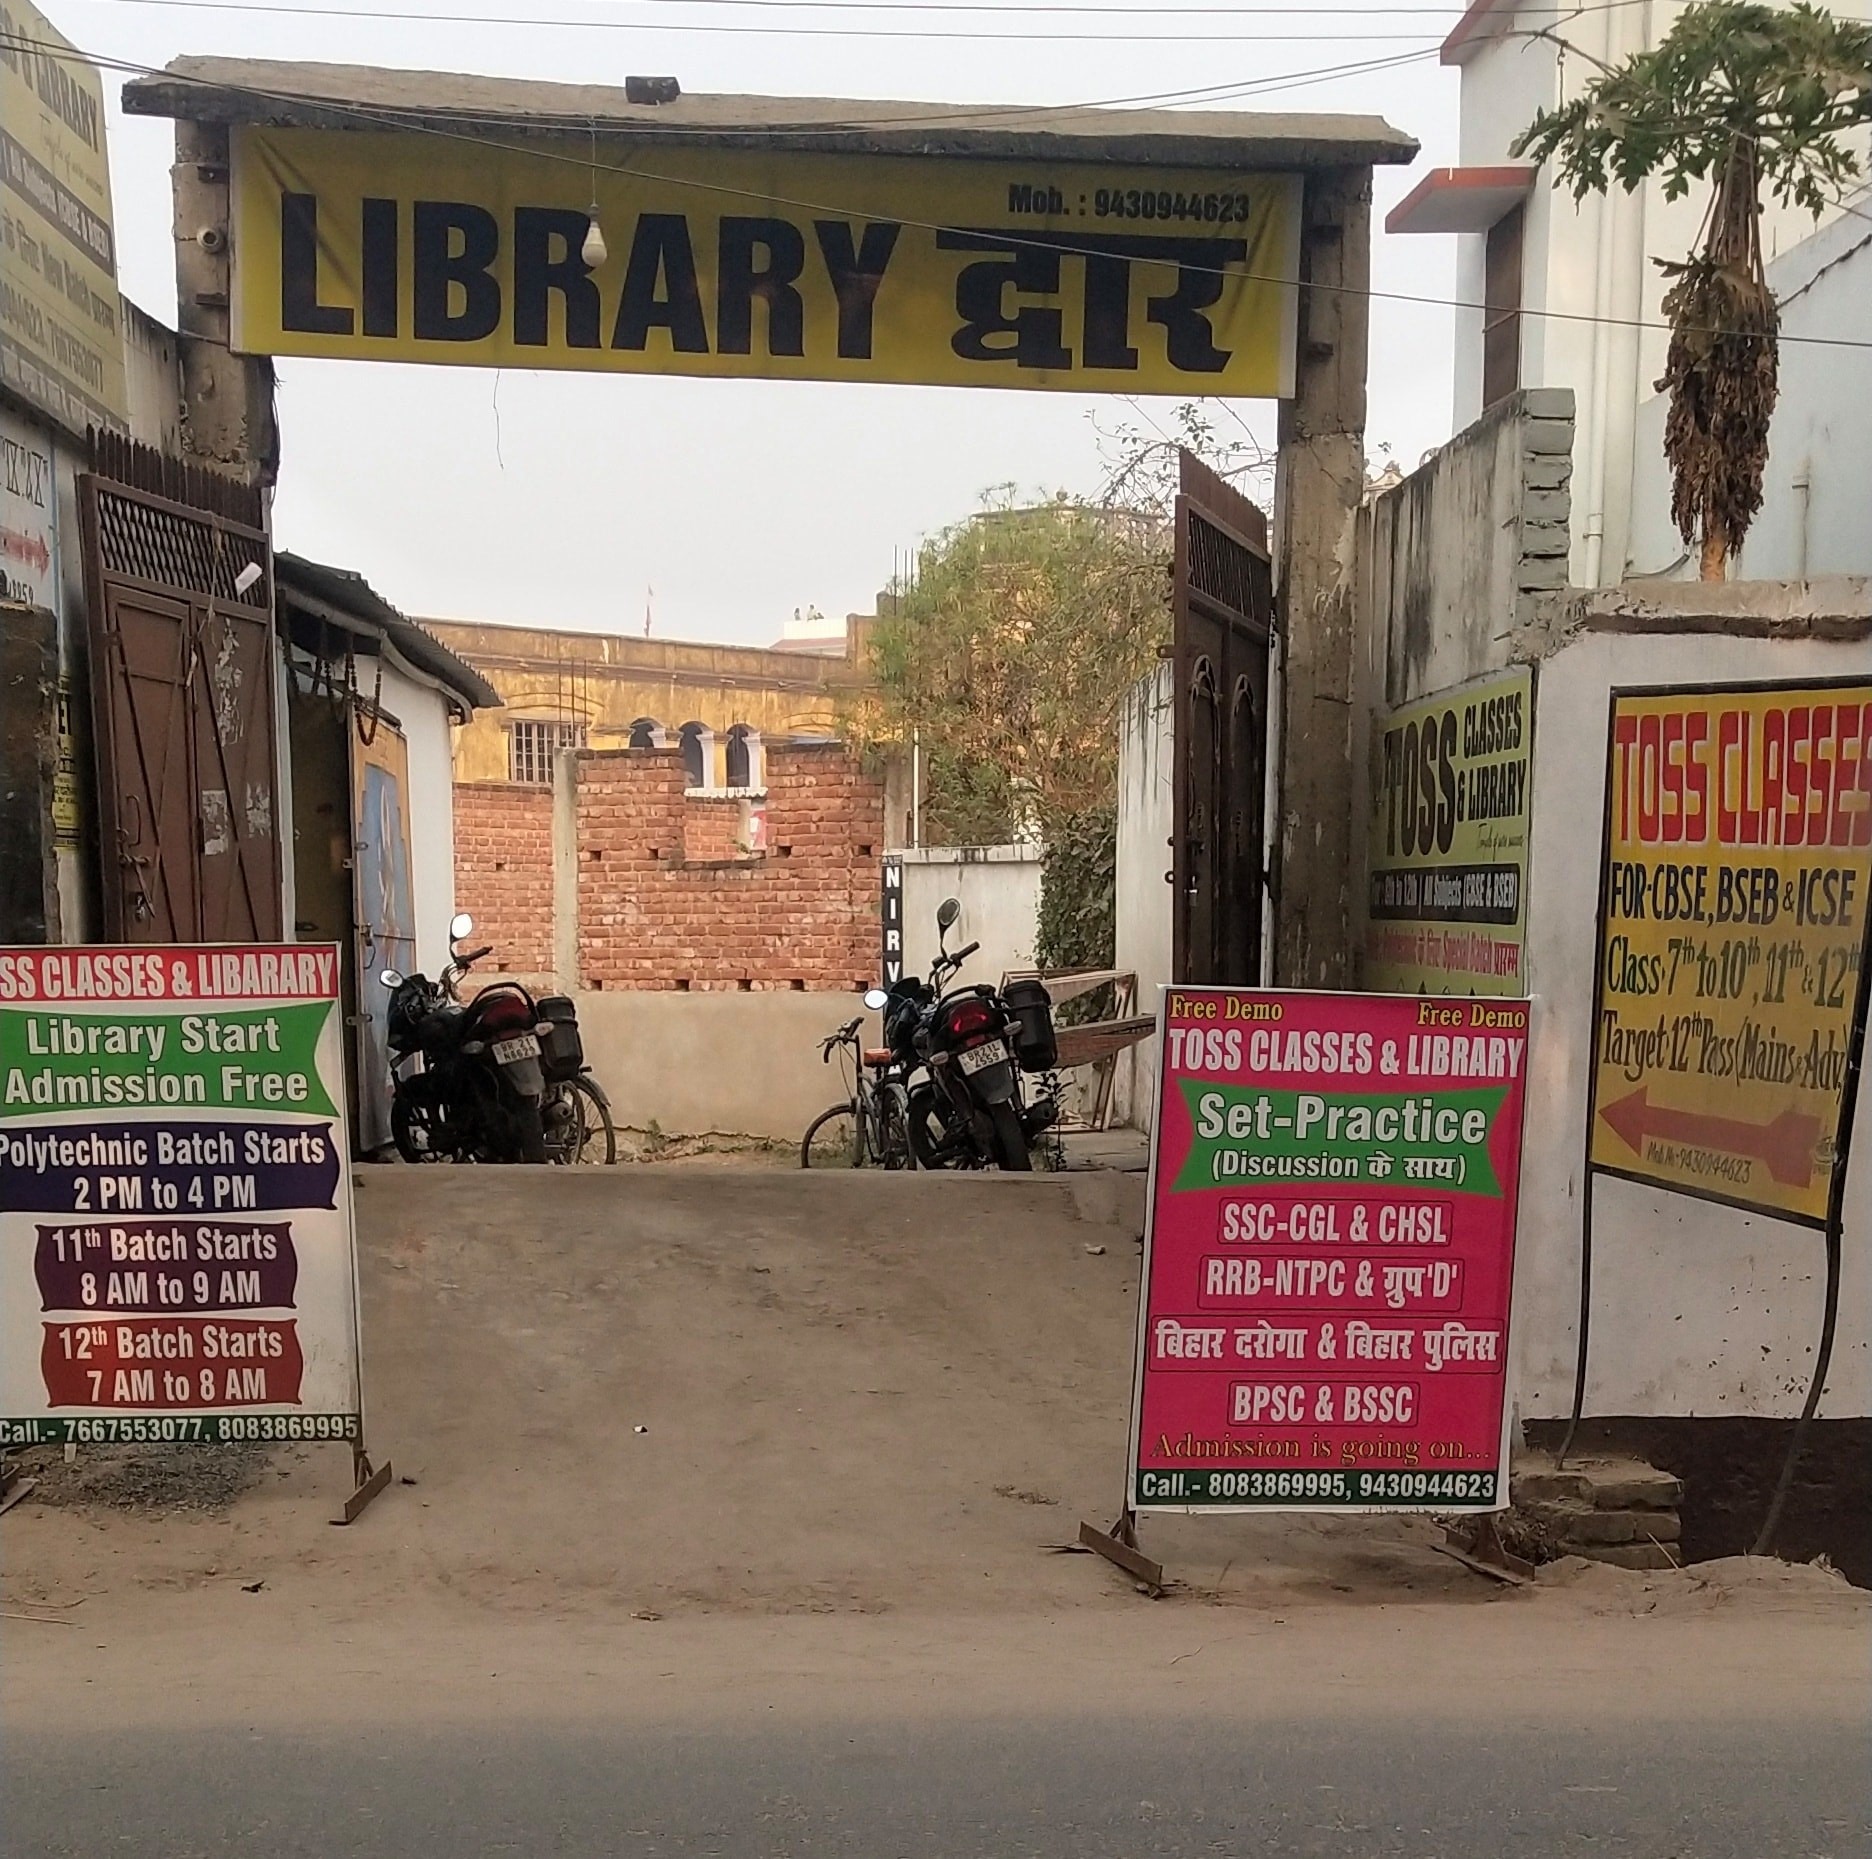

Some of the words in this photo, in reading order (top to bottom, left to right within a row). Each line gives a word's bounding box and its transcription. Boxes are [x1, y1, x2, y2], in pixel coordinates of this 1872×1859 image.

[1094, 189, 1249, 222] 9430944623
[281, 191, 901, 360] LIBRARY
[936, 226, 1248, 373] द्वार
[1384, 709, 1457, 857] TOSS
[1464, 691, 1522, 759] CLASSES
[1467, 758, 1526, 821] LIBRARY
[1616, 711, 1709, 846] TOSS
[1434, 873, 1462, 910] Subjects
[1716, 866, 1779, 926] BSEB
[1796, 867, 1856, 927] ICSE
[886, 866, 900, 983] NIRV
[42, 954, 165, 998] CLASSES
[171, 961, 193, 996] &
[197, 952, 334, 996] LIBARARY
[1169, 995, 1217, 1020] Free
[1224, 996, 1284, 1021] Demo
[1417, 1002, 1463, 1027] Free
[1469, 1004, 1526, 1029] Demo
[26, 1017, 166, 1062] Library
[181, 1016, 281, 1053] Start
[1169, 1028, 1242, 1071] TOSS
[1250, 1029, 1373, 1074] CLASSES
[1380, 1039, 1400, 1075] &
[1407, 1034, 1525, 1079] LIBRARY
[5, 1065, 205, 1104] Admission
[220, 1066, 308, 1102] Free
[1197, 1092, 1487, 1144] Set-Practice
[0, 1131, 148, 1174] Polytechnic
[156, 1131, 235, 1165] Batch
[244, 1130, 325, 1164] Starts
[1212, 1149, 1359, 1181] (Discussion
[1366, 1150, 1395, 1178] के
[73, 1177, 90, 1210] 2
[100, 1176, 143, 1209] PM
[151, 1176, 178, 1209] to
[187, 1176, 204, 1208] 4
[213, 1174, 257, 1208] PM
[1223, 1203, 1340, 1241] SSC-CGL
[1350, 1205, 1368, 1241] &
[1379, 1205, 1446, 1243] CHSL
[52, 1227, 102, 1262] 11th
[110, 1227, 188, 1261] Batch
[196, 1226, 278, 1260] Starts
[81, 1272, 97, 1306] 8
[107, 1272, 148, 1305] AM
[157, 1272, 184, 1304] to
[193, 1272, 209, 1304] 9
[219, 1271, 261, 1303] AM
[1206, 1259, 1345, 1297] RRB-NTPC
[1354, 1260, 1374, 1297] &
[59, 1326, 108, 1360] 12th
[116, 1325, 194, 1359] Batch
[203, 1325, 283, 1358] Starts
[1155, 1319, 1225, 1359] बिहार
[1234, 1319, 1308, 1359] दरोगा
[1317, 1322, 1336, 1360] &
[1345, 1320, 1415, 1361] बिहार
[1423, 1322, 1500, 1371] पुलिस
[87, 1371, 103, 1402] 7
[113, 1369, 155, 1402] AM
[163, 1369, 190, 1401] to
[199, 1369, 216, 1400] 8
[225, 1367, 267, 1400] AM
[1233, 1385, 1305, 1422] BPSC
[1314, 1385, 1334, 1422] &
[1343, 1385, 1413, 1423] BSSC
[63, 1418, 212, 1443] 7667553077,
[218, 1417, 358, 1440] 8083869995
[1151, 1432, 1300, 1459] Admission
[1310, 1433, 1331, 1459] is
[1341, 1434, 1422, 1466] going
[1429, 1441, 1490, 1460] on...
[1208, 1472, 1352, 1501] 8083869995,
[1359, 1473, 1495, 1499] 9430944623
